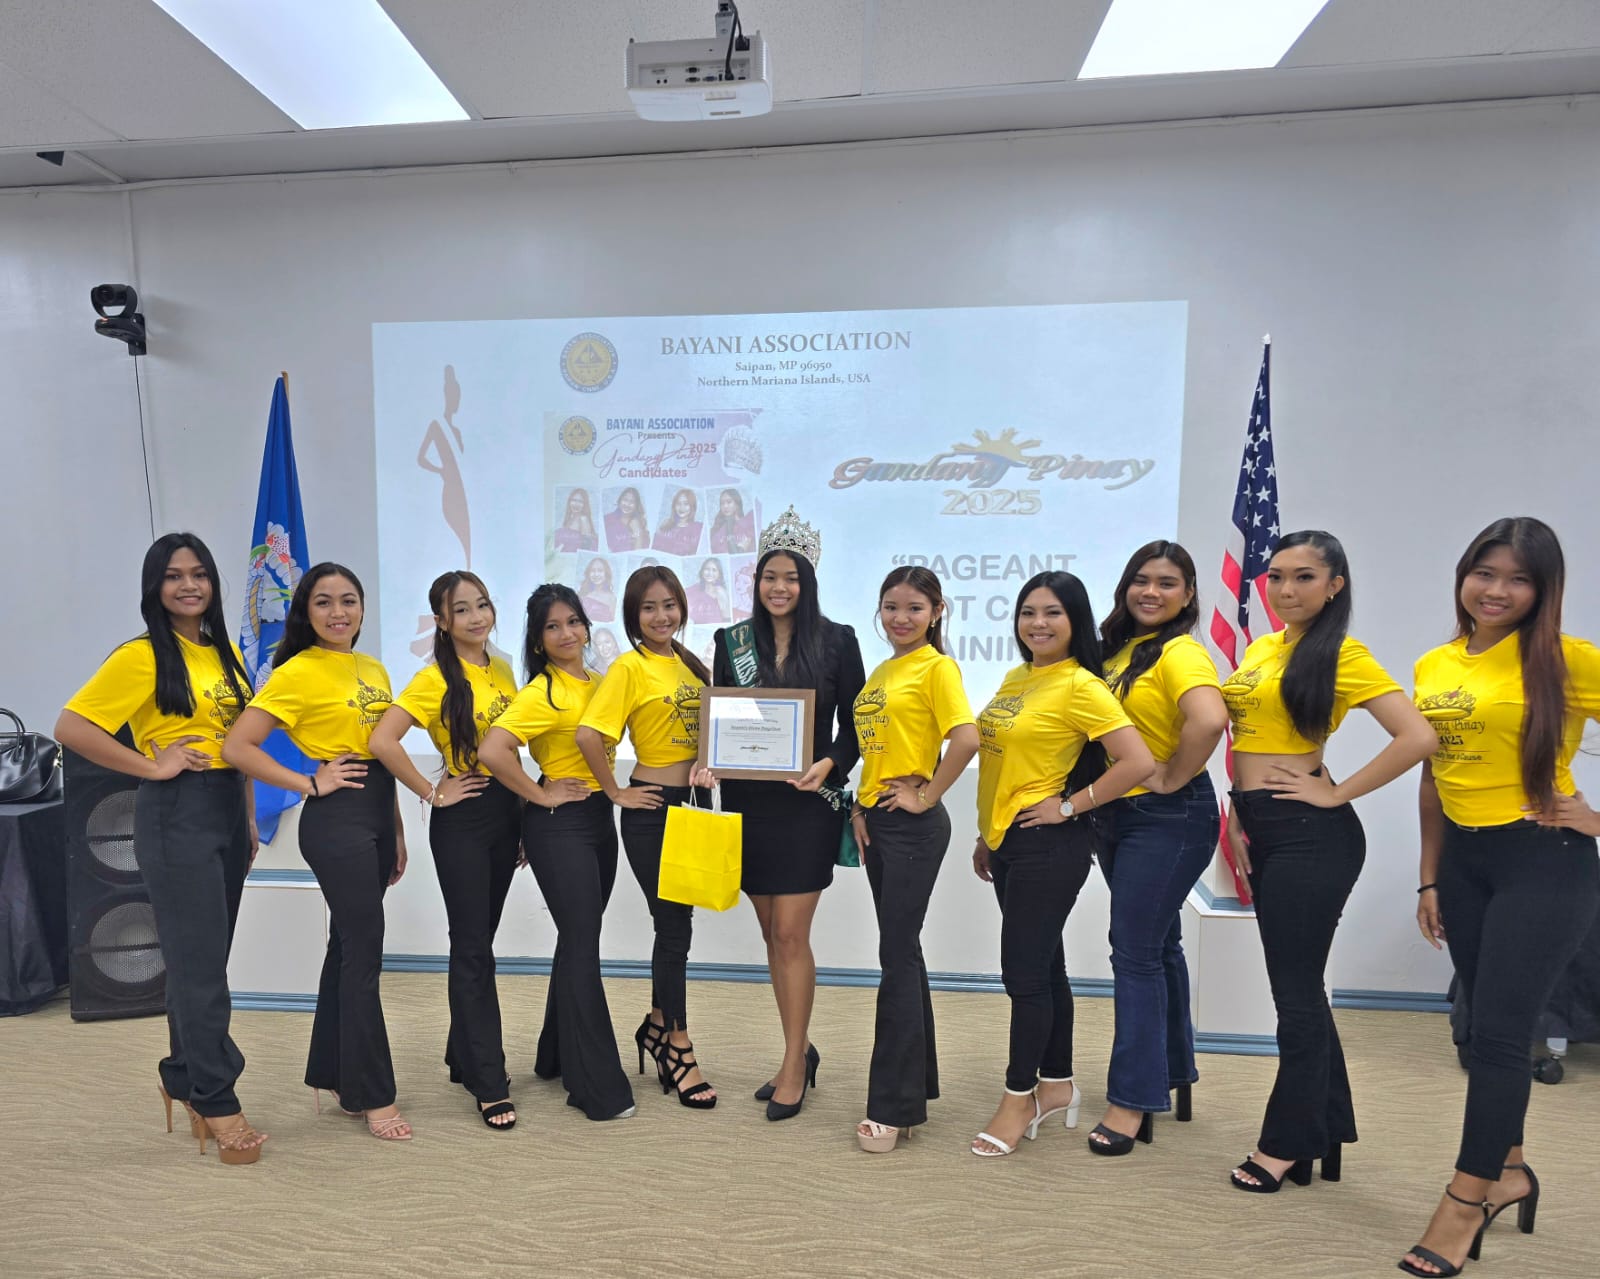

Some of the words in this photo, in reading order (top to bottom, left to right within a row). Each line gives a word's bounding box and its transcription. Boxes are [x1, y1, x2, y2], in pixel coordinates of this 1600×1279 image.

[661, 336, 743, 355] BAYANI
[748, 331, 912, 353] ASSOCIATION
[735, 361, 776, 373] Saipan,
[779, 360, 797, 371] MP
[800, 361, 832, 372] 96950
[697, 376, 749, 387] Northern
[751, 375, 798, 386] Mariana
[800, 373, 845, 386] Islands,
[848, 373, 871, 384] USA
[606, 418, 644, 430] BAYANI
[648, 417, 715, 429] ASSOCIATION
[637, 431, 676, 440] Presents
[690, 443, 717, 453] 2025
[618, 467, 688, 478] Candidates
[828, 452, 1011, 490] Gandang
[1026, 454, 1156, 491] Pinay
[940, 489, 1042, 516] 2025
[1453, 719, 1486, 735] Pinay
